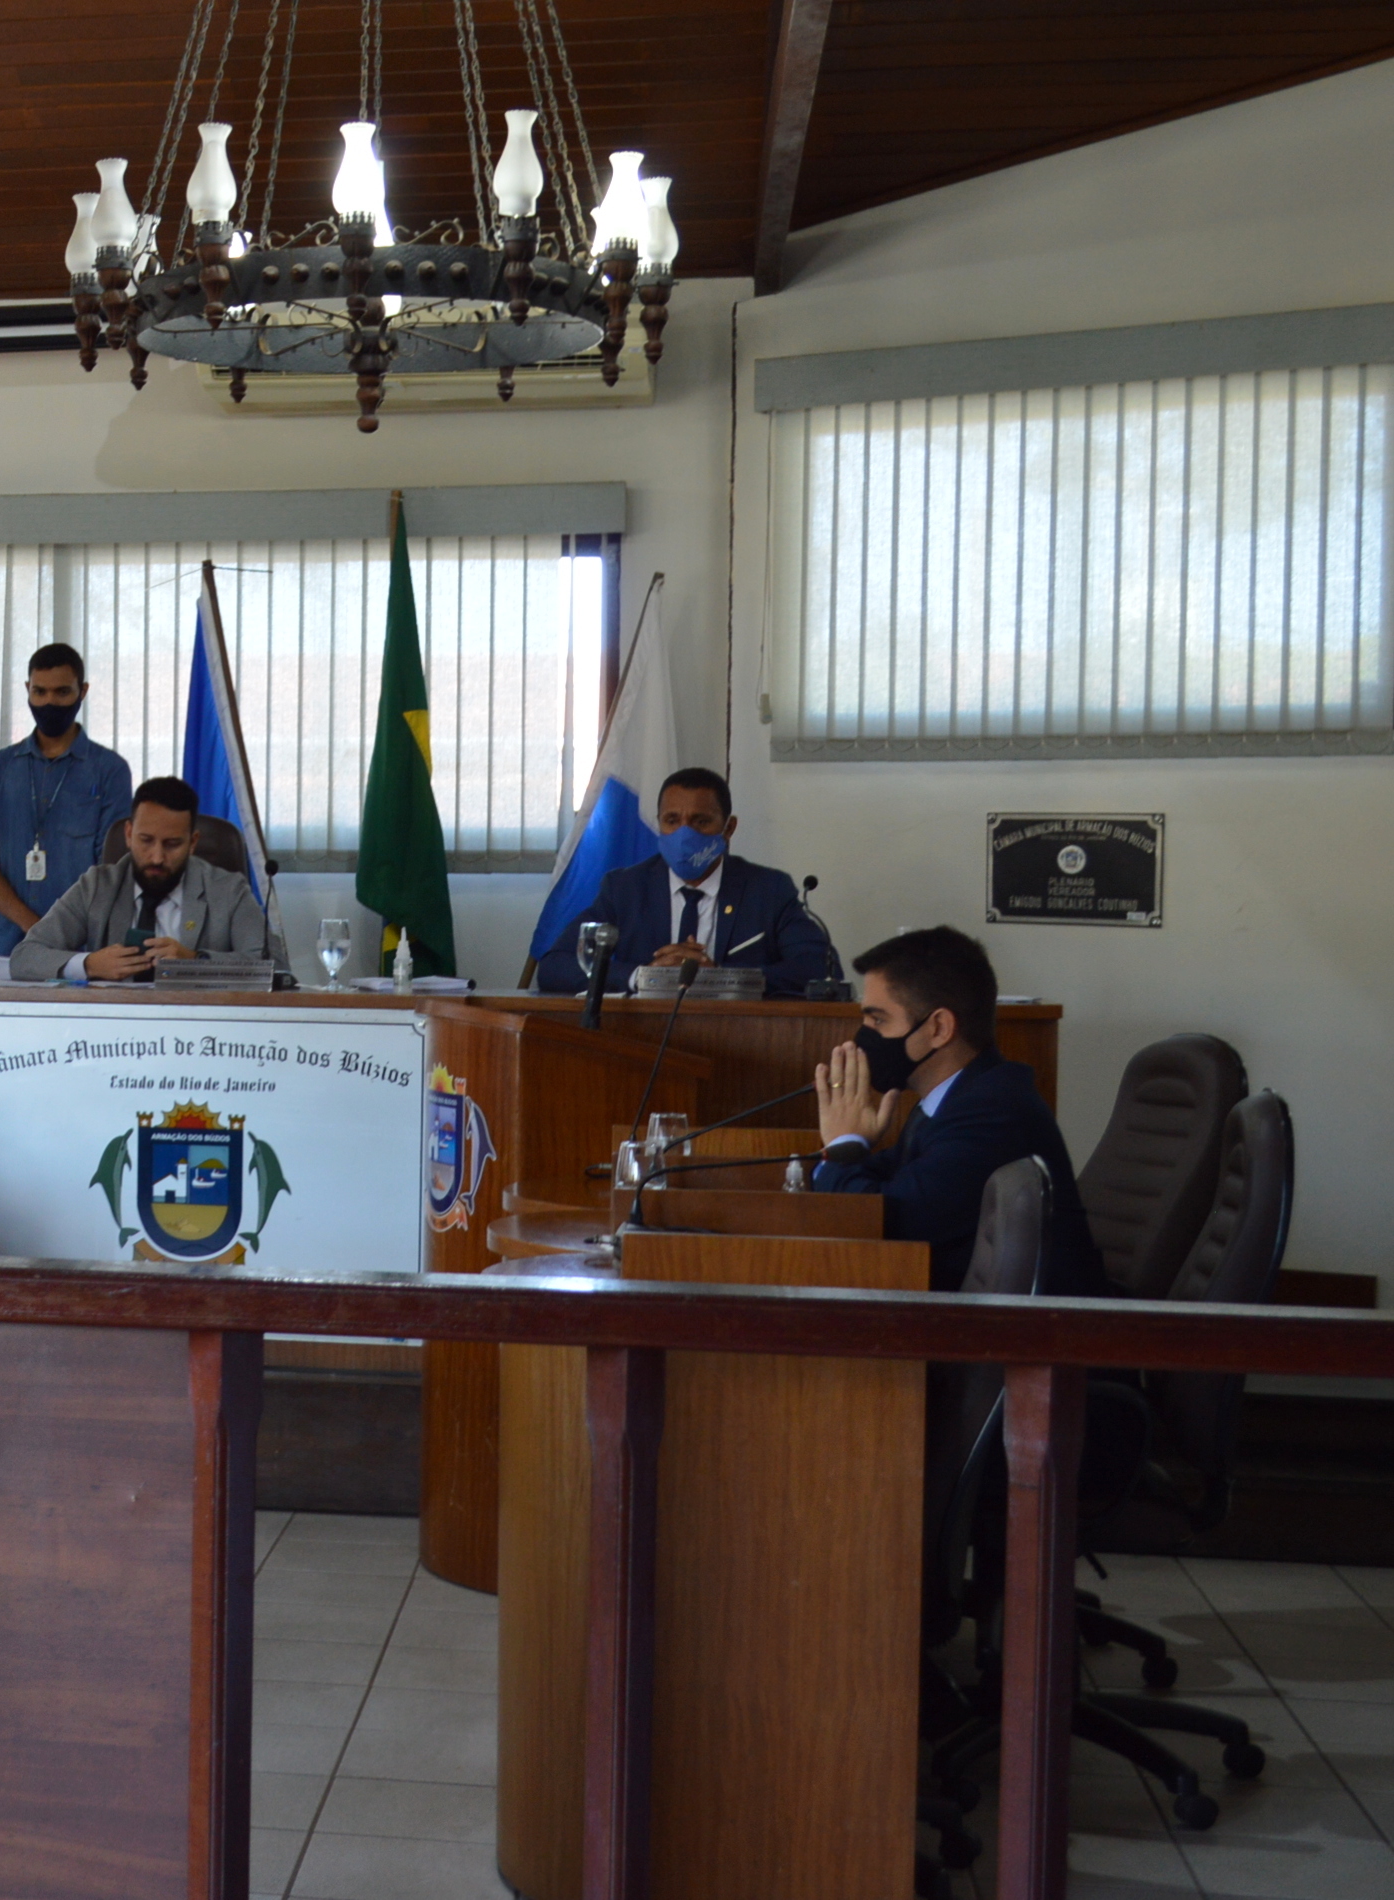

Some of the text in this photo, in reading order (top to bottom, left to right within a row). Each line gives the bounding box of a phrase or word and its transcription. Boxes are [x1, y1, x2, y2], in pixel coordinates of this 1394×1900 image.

[64, 1036, 166, 1064] Municipal
[174, 1036, 195, 1056] de
[199, 1035, 289, 1067] Armação
[296, 1045, 332, 1068] dos
[337, 1049, 414, 1087] Búzios
[109, 1075, 276, 1092] Estado do Rio de Janeiro
